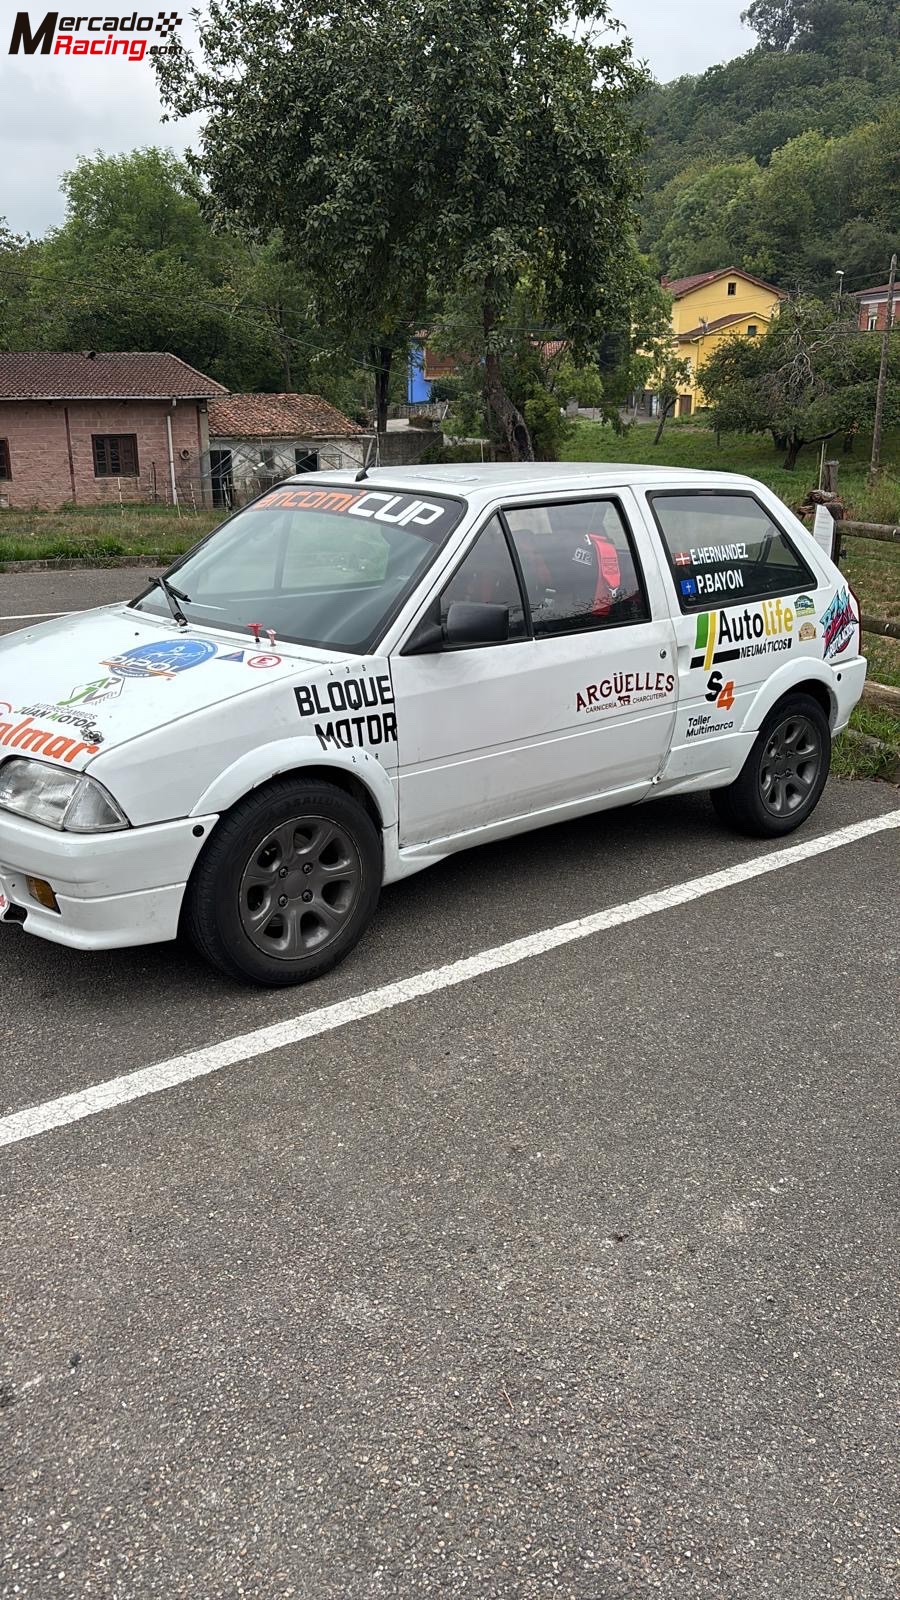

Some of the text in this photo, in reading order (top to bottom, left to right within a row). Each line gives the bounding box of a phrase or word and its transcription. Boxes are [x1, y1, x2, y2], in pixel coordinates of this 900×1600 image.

[690, 543, 749, 565] E.HERNANDEZ
[696, 569, 744, 594] P.BAYON
[718, 599, 794, 645] Autolife
[740, 638, 788, 658] NEUMÁTICOS
[293, 675, 394, 717] BLOQUE
[576, 671, 675, 713] ARGÜELLES
[705, 670, 735, 711] S4
[46, 713, 97, 730] MOTOR
[314, 712, 398, 751] MOTOR
[685, 721, 734, 738] Multimarca
[688, 715, 711, 727] Taller
